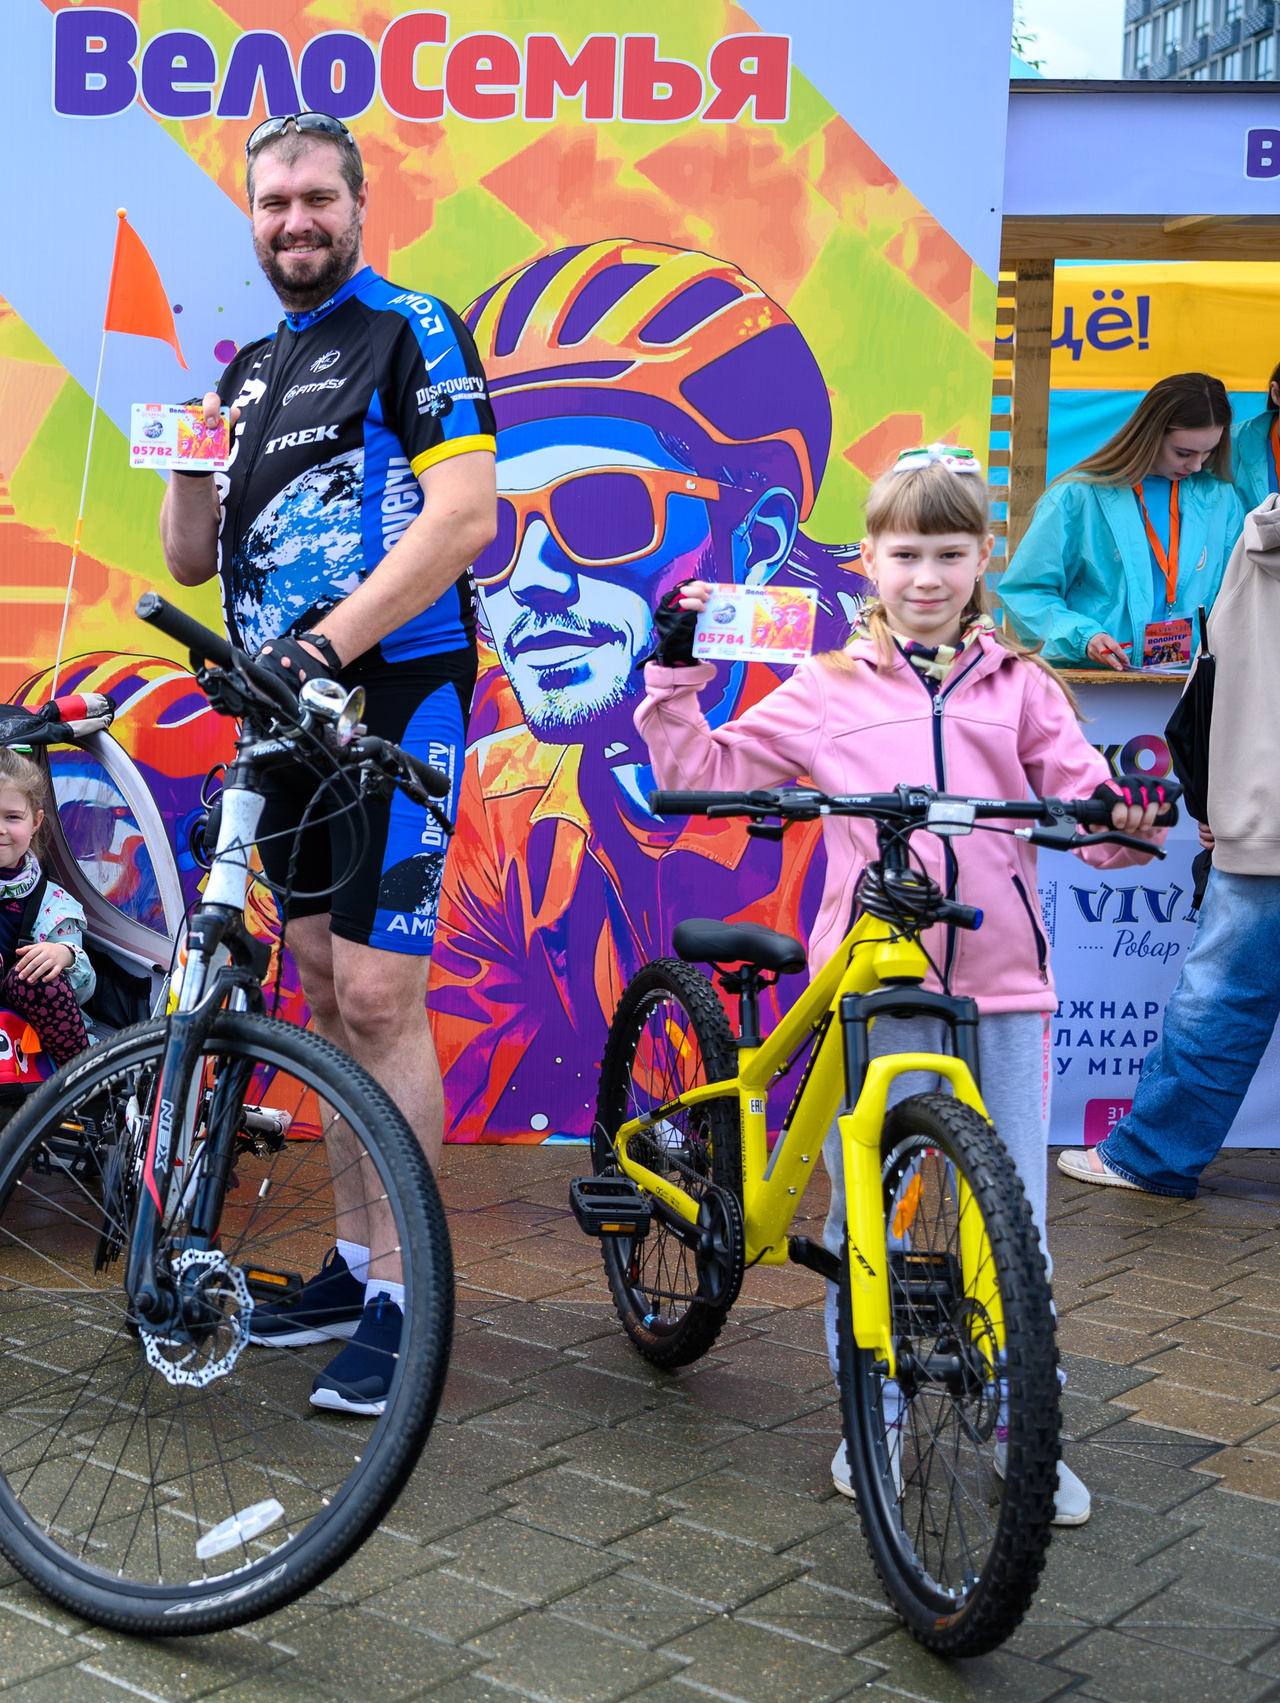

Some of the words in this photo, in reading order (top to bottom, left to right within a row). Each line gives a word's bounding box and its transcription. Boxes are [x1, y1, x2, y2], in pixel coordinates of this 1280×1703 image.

[54, 10, 790, 121] ВелоСемья
[387, 293, 433, 315] AMD
[132, 445, 173, 456] 05782
[265, 424, 340, 455] TREK
[697, 632, 745, 645] 05784
[1069, 882, 1196, 924] VIV
[386, 914, 436, 937] AMD
[1053, 1001, 1167, 1019] ІЖНАР
[750, 1099, 764, 1113] EAC
[155, 1099, 174, 1174] NEX
